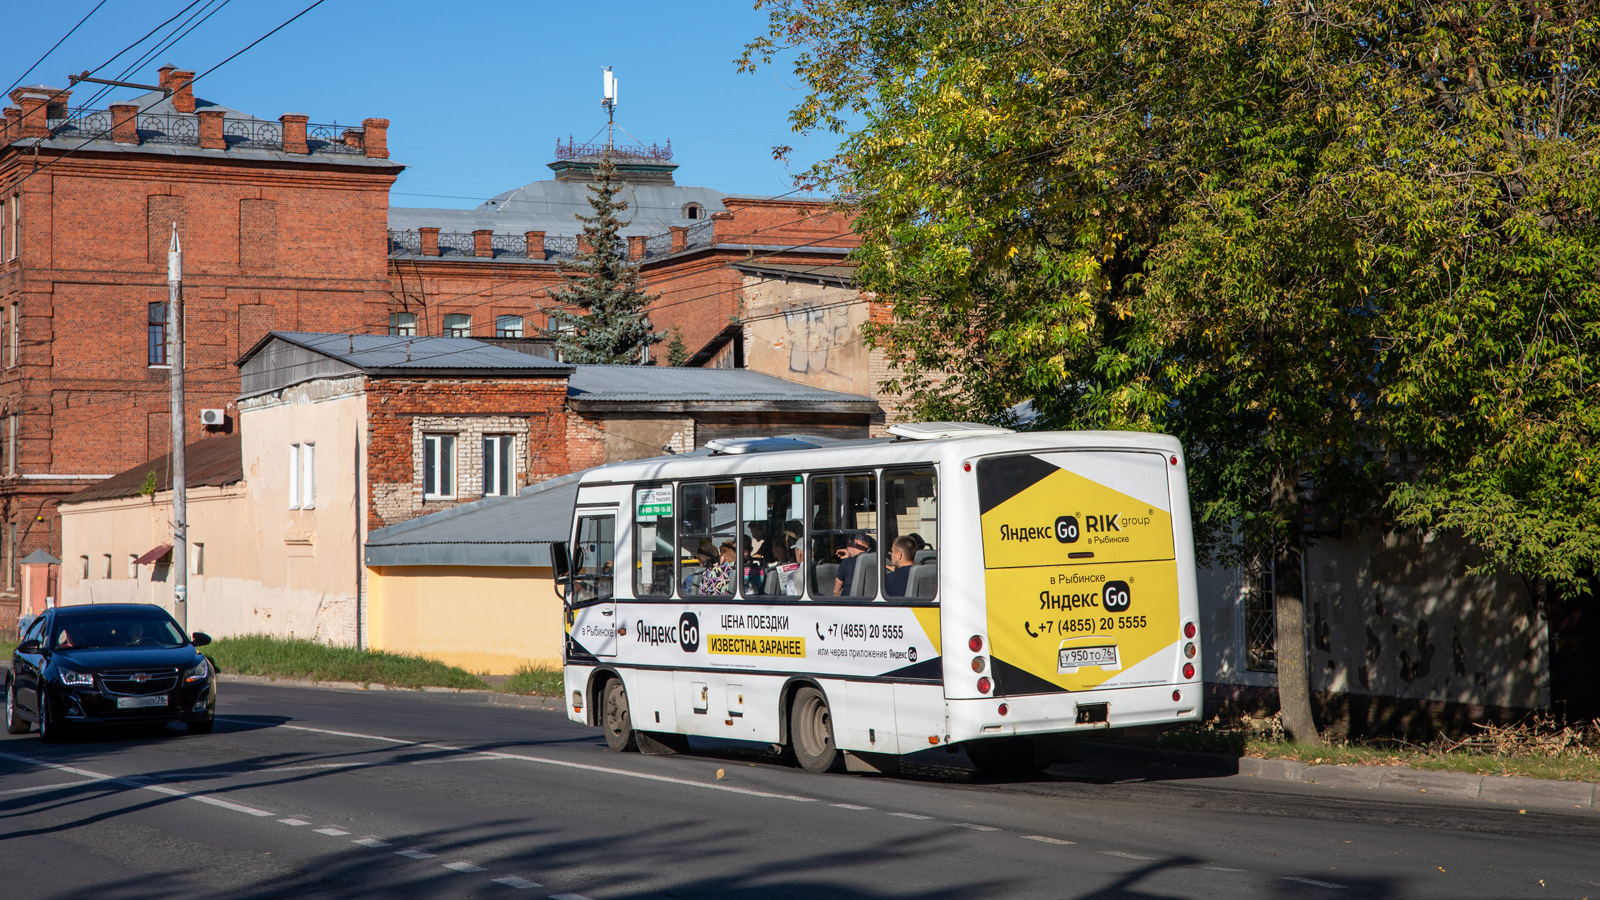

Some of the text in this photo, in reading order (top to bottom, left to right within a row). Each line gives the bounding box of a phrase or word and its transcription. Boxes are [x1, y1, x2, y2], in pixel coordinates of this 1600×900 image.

[1000, 514, 1150, 542] Яндекс Go RIK group
[1094, 536, 1130, 544] Рыбинске
[1050, 573, 1106, 585] в Рыбинске
[1039, 587, 1128, 612] Яндекс Go
[587, 625, 614, 637] Рыбинске
[636, 619, 698, 646] Яндекс Go
[721, 614, 789, 633] ЦЕНА ПОЕЗДКИ
[828, 623, 904, 642] +7 (4855) 20 5555
[1038, 615, 1147, 637] +7 (4855) 20 5555
[711, 637, 802, 655] ИЗВЕСТНА ЗАРАНЕЕ
[817, 648, 829, 656] или
[830, 648, 848, 658] через
[849, 649, 888, 659] приложение
[888, 649, 907, 660] Яндекс
